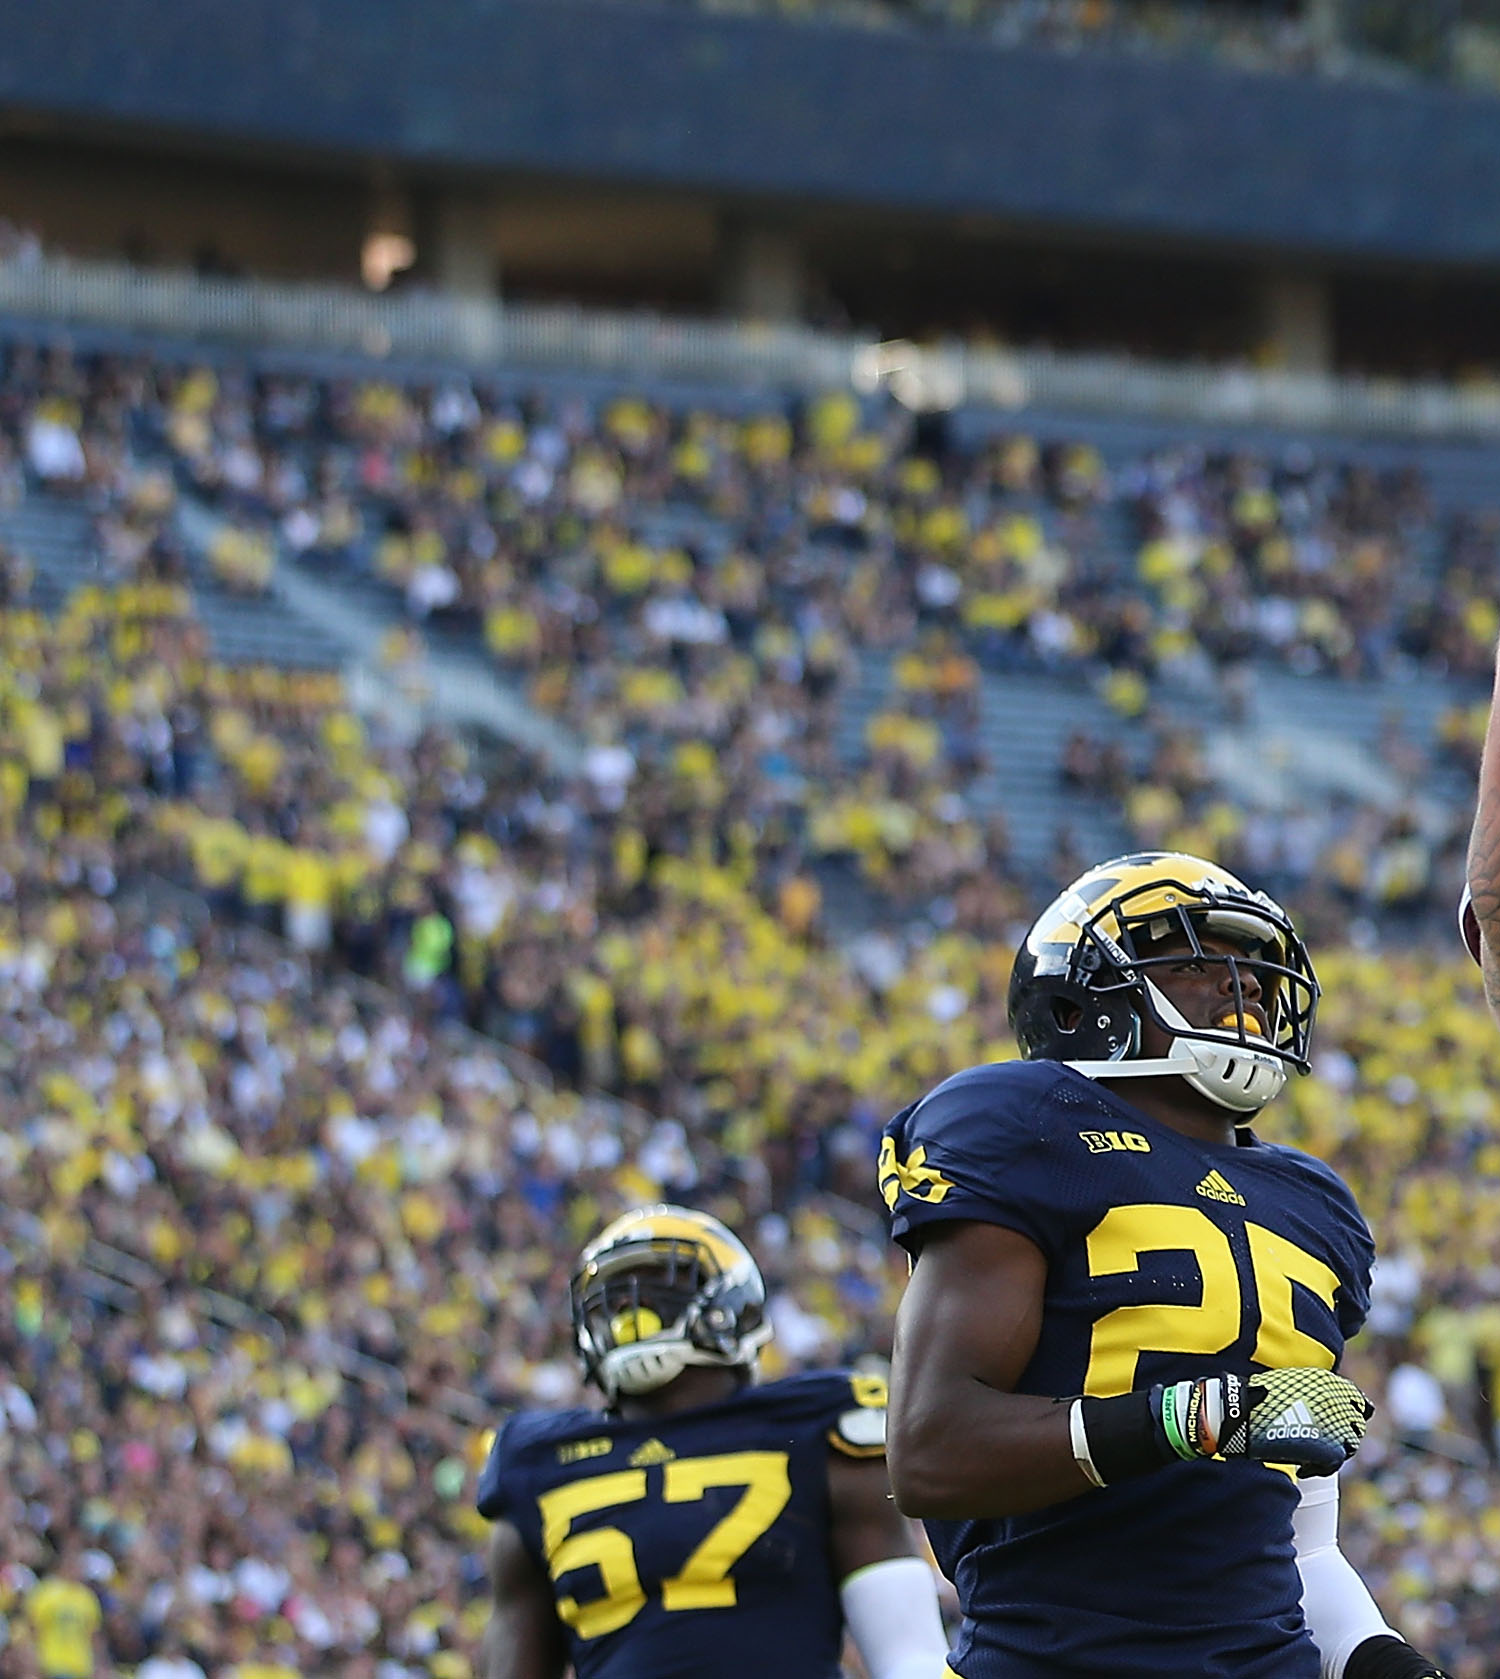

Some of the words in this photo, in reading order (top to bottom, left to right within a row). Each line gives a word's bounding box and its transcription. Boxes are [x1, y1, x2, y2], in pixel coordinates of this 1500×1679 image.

[1195, 1185, 1247, 1207] adidas
[1084, 1204, 1341, 1482] 25
[1266, 1423, 1320, 1441] adidas
[537, 1450, 792, 1640] 57
